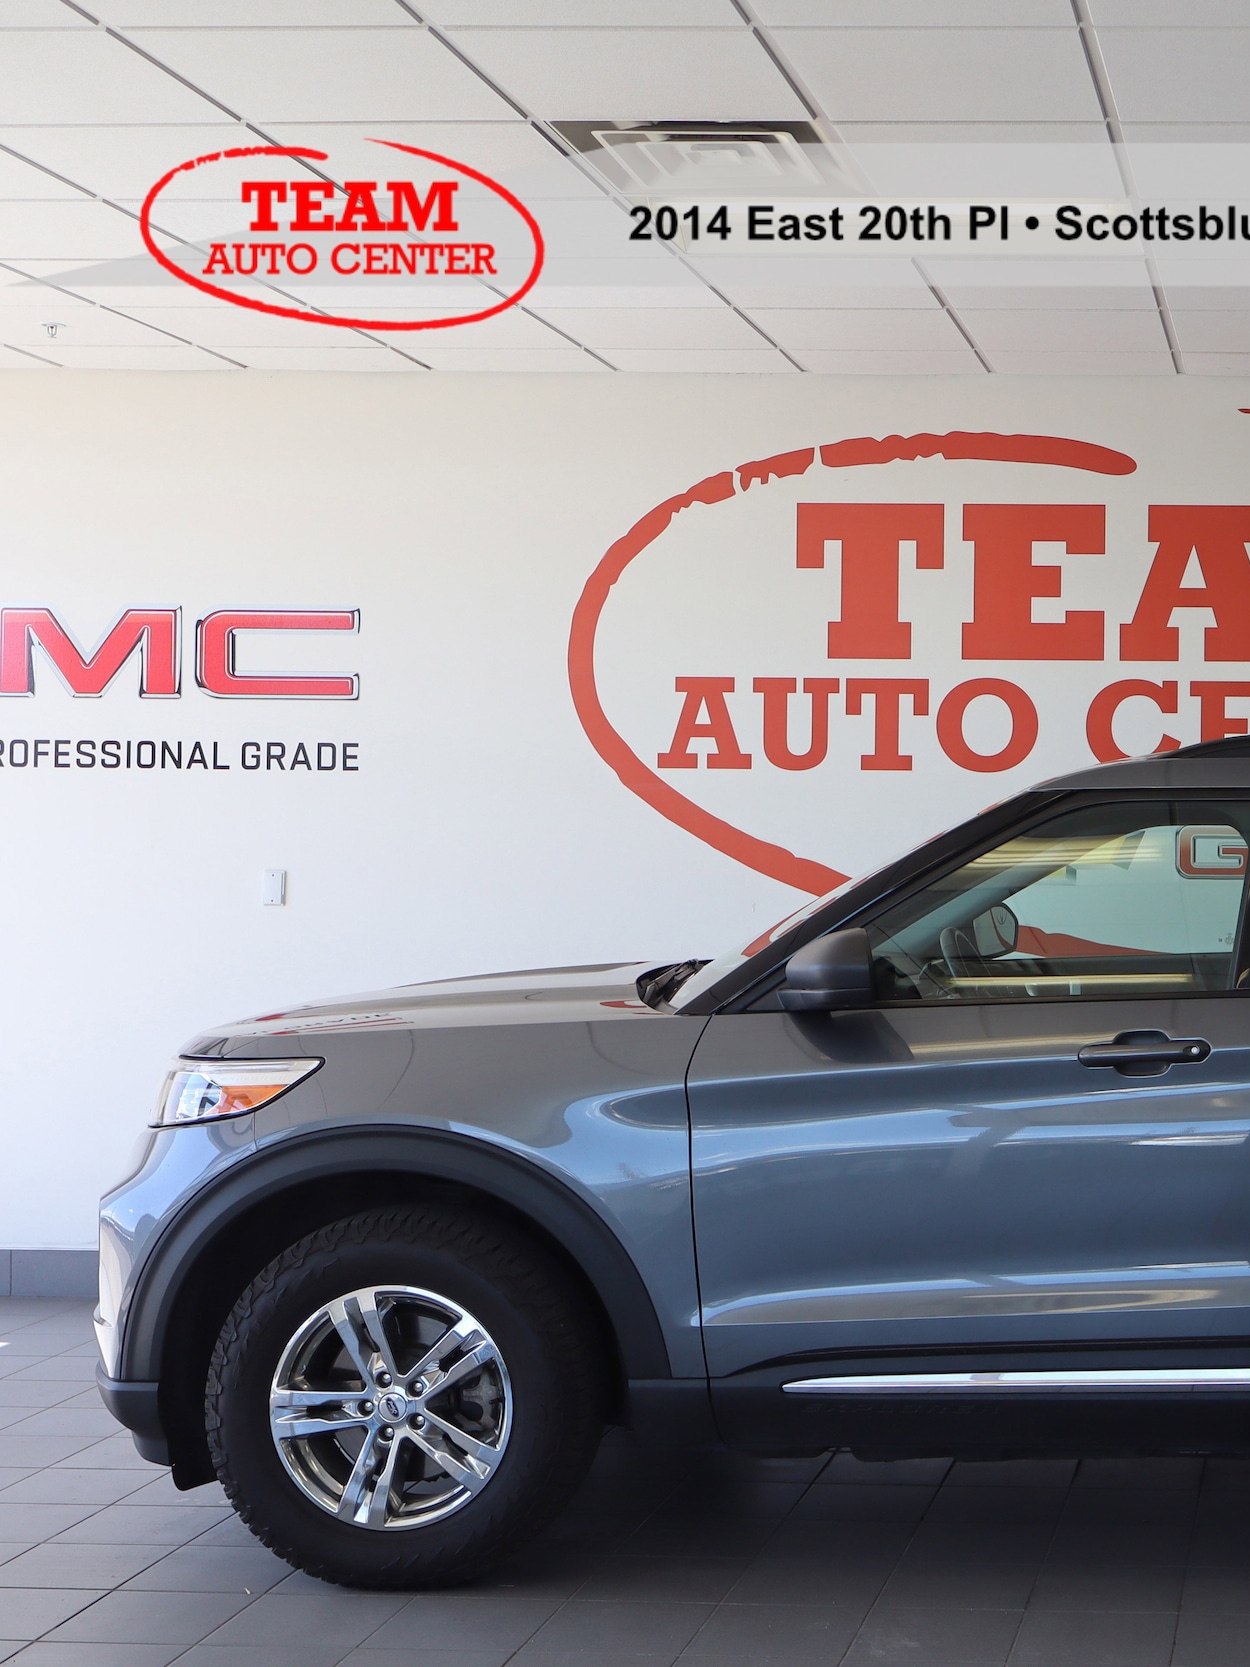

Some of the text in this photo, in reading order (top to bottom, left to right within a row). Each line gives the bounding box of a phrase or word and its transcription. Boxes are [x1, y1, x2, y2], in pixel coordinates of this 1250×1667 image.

[0, 740, 358, 770] OFESSIONAL GRADE
[657, 677, 1038, 773] AUTO
